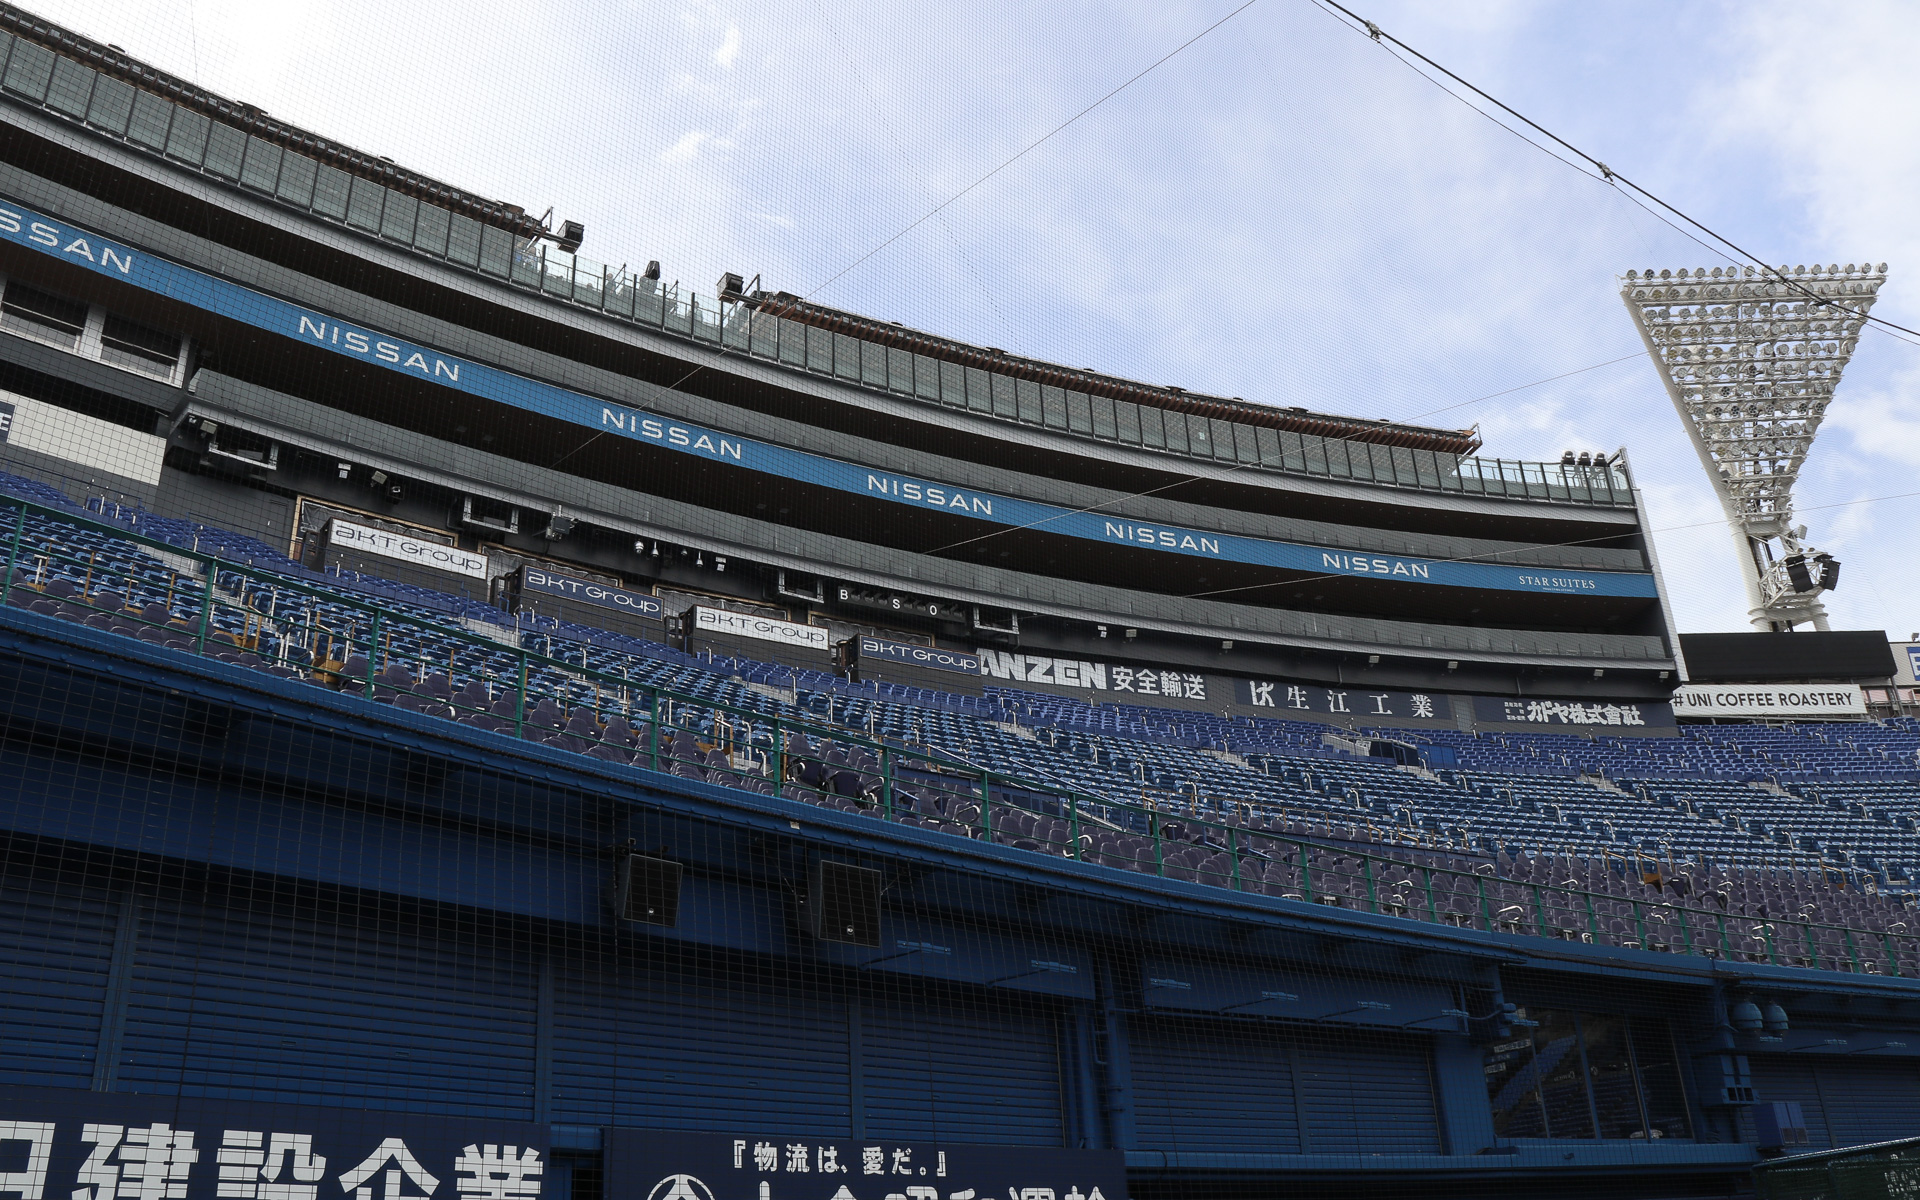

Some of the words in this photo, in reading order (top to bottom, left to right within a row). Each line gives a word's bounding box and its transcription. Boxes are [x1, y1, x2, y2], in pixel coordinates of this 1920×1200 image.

[299, 316, 459, 382] NISSAN
[602, 408, 741, 460] NISSAN
[868, 474, 992, 515] NISSAN
[1105, 521, 1219, 554] NISSAN
[1322, 553, 1429, 578] NISSAN
[1518, 575, 1550, 587] STAR
[1552, 577, 1596, 589] SUITES
[840, 589, 848, 600] B
[892, 598, 901, 609] S
[1112, 665, 1206, 700] 安全輸送
[1287, 685, 1434, 718] 生江工業
[1686, 693, 1713, 707] UNI
[1716, 692, 1775, 707] COFFEE
[1779, 692, 1852, 706] ROASTERY
